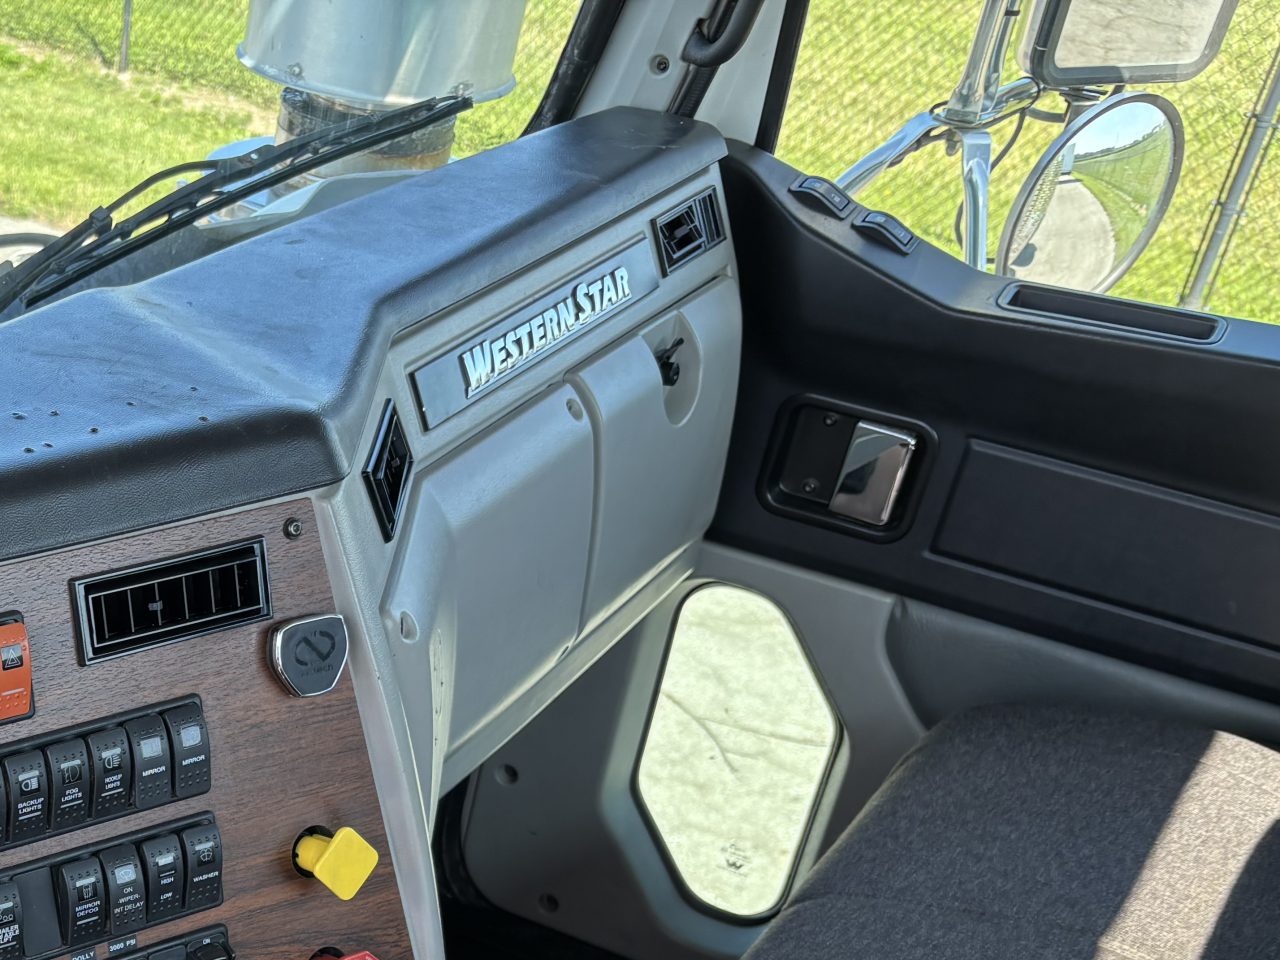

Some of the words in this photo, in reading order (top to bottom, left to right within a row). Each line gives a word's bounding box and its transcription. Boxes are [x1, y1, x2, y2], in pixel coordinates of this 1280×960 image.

[462, 297, 577, 395] WESTERN
[573, 266, 632, 328] STAR
[182, 754, 205, 766] MIRROR
[142, 765, 166, 777] MIRROR
[105, 780, 121, 790] LIGHTS
[61, 792, 82, 802] LIGHTS
[65, 787, 79, 796] FOG
[17, 797, 44, 809] BACKUP
[18, 803, 42, 815] LIGHTS
[160, 877, 174, 885] HIGH
[193, 871, 219, 883] WASHER
[123, 886, 133, 894] ON
[160, 892, 173, 900] LOW
[75, 900, 101, 912] MIRROR
[76, 907, 99, 917] DEFOG
[114, 905, 124, 914] INT
[124, 901, 144, 912] DELAY
[109, 942, 125, 952] 3000
[126, 938, 136, 947] PSI
